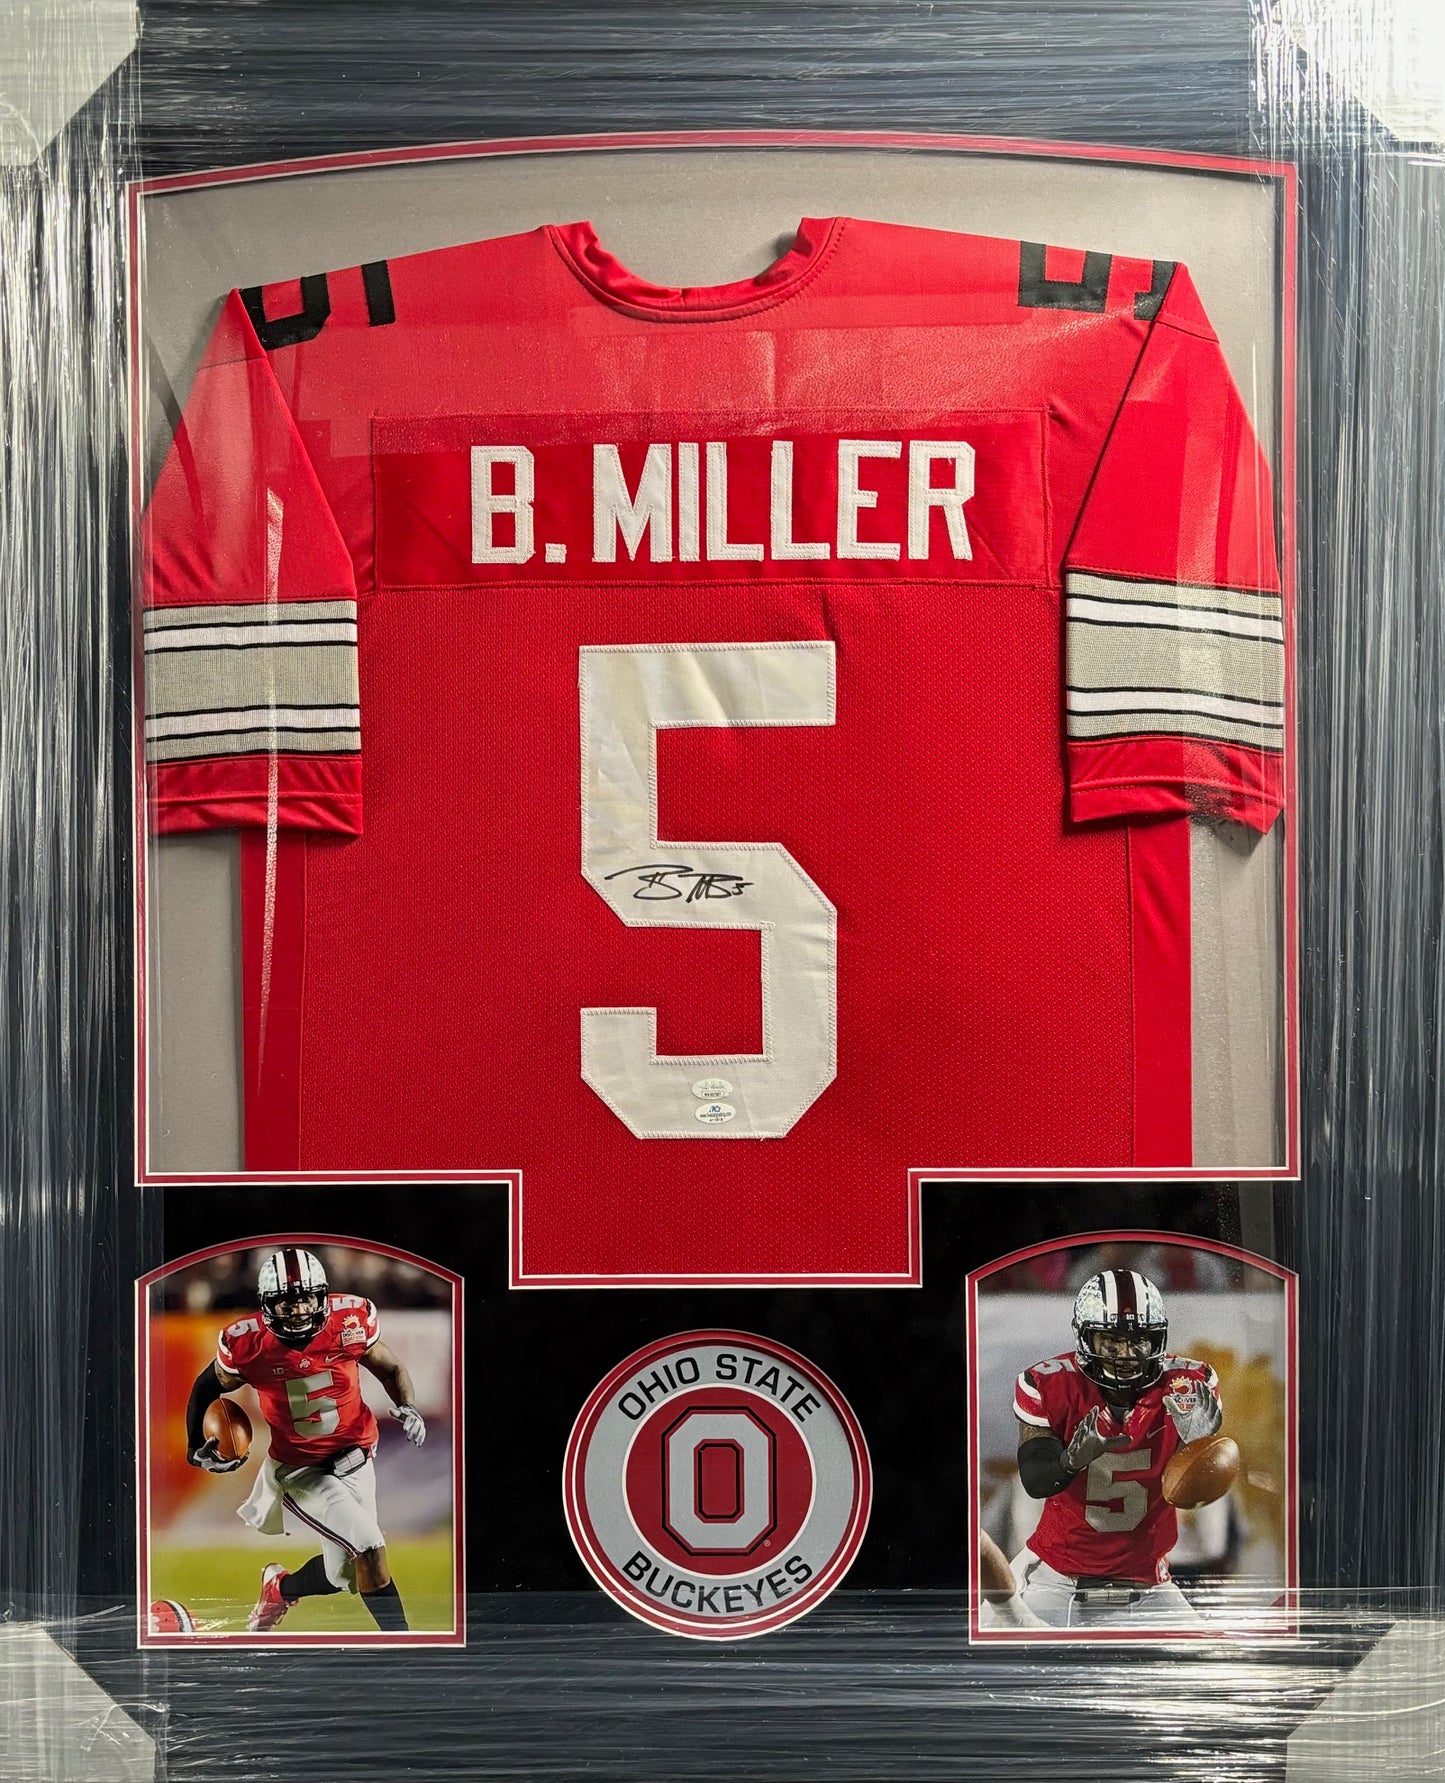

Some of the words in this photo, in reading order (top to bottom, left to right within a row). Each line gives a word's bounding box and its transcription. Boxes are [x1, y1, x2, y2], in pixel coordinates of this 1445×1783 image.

[471, 445, 567, 564] B.
[592, 440, 976, 563] MILLER
[579, 640, 838, 1140] 5
[227, 1318, 260, 1338] 5
[617, 1356, 700, 1421] OHIO
[716, 1353, 822, 1423] STATE
[1032, 1358, 1077, 1375] 5
[286, 1370, 340, 1438] 5
[1084, 1448, 1151, 1533] 5
[622, 1550, 813, 1613] BUCKEYES
